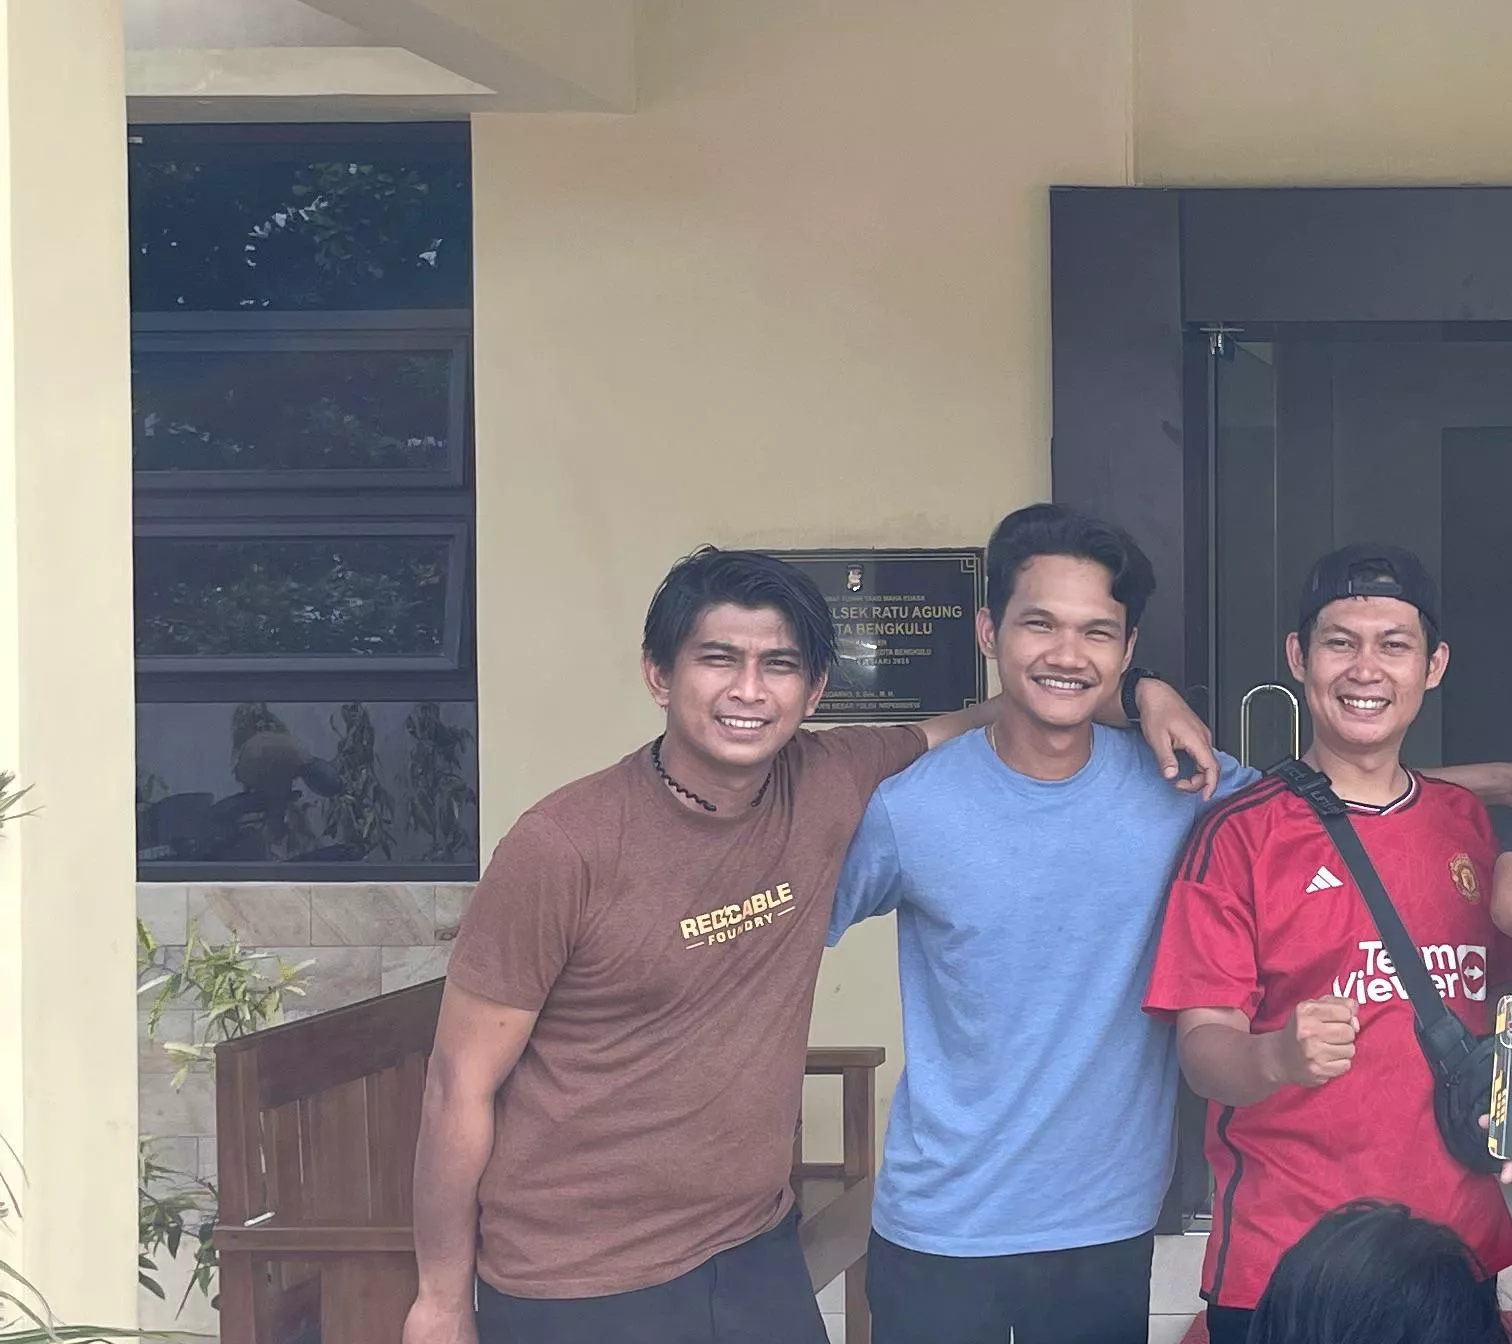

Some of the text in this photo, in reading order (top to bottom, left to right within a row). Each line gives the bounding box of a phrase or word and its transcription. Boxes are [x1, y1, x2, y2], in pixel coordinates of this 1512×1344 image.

[830, 604, 962, 619] LSEK RATU AGUNG
[856, 621, 933, 636] BENGKULU
[707, 912, 774, 946] FOUNDRY
[1358, 940, 1457, 976] Tem
